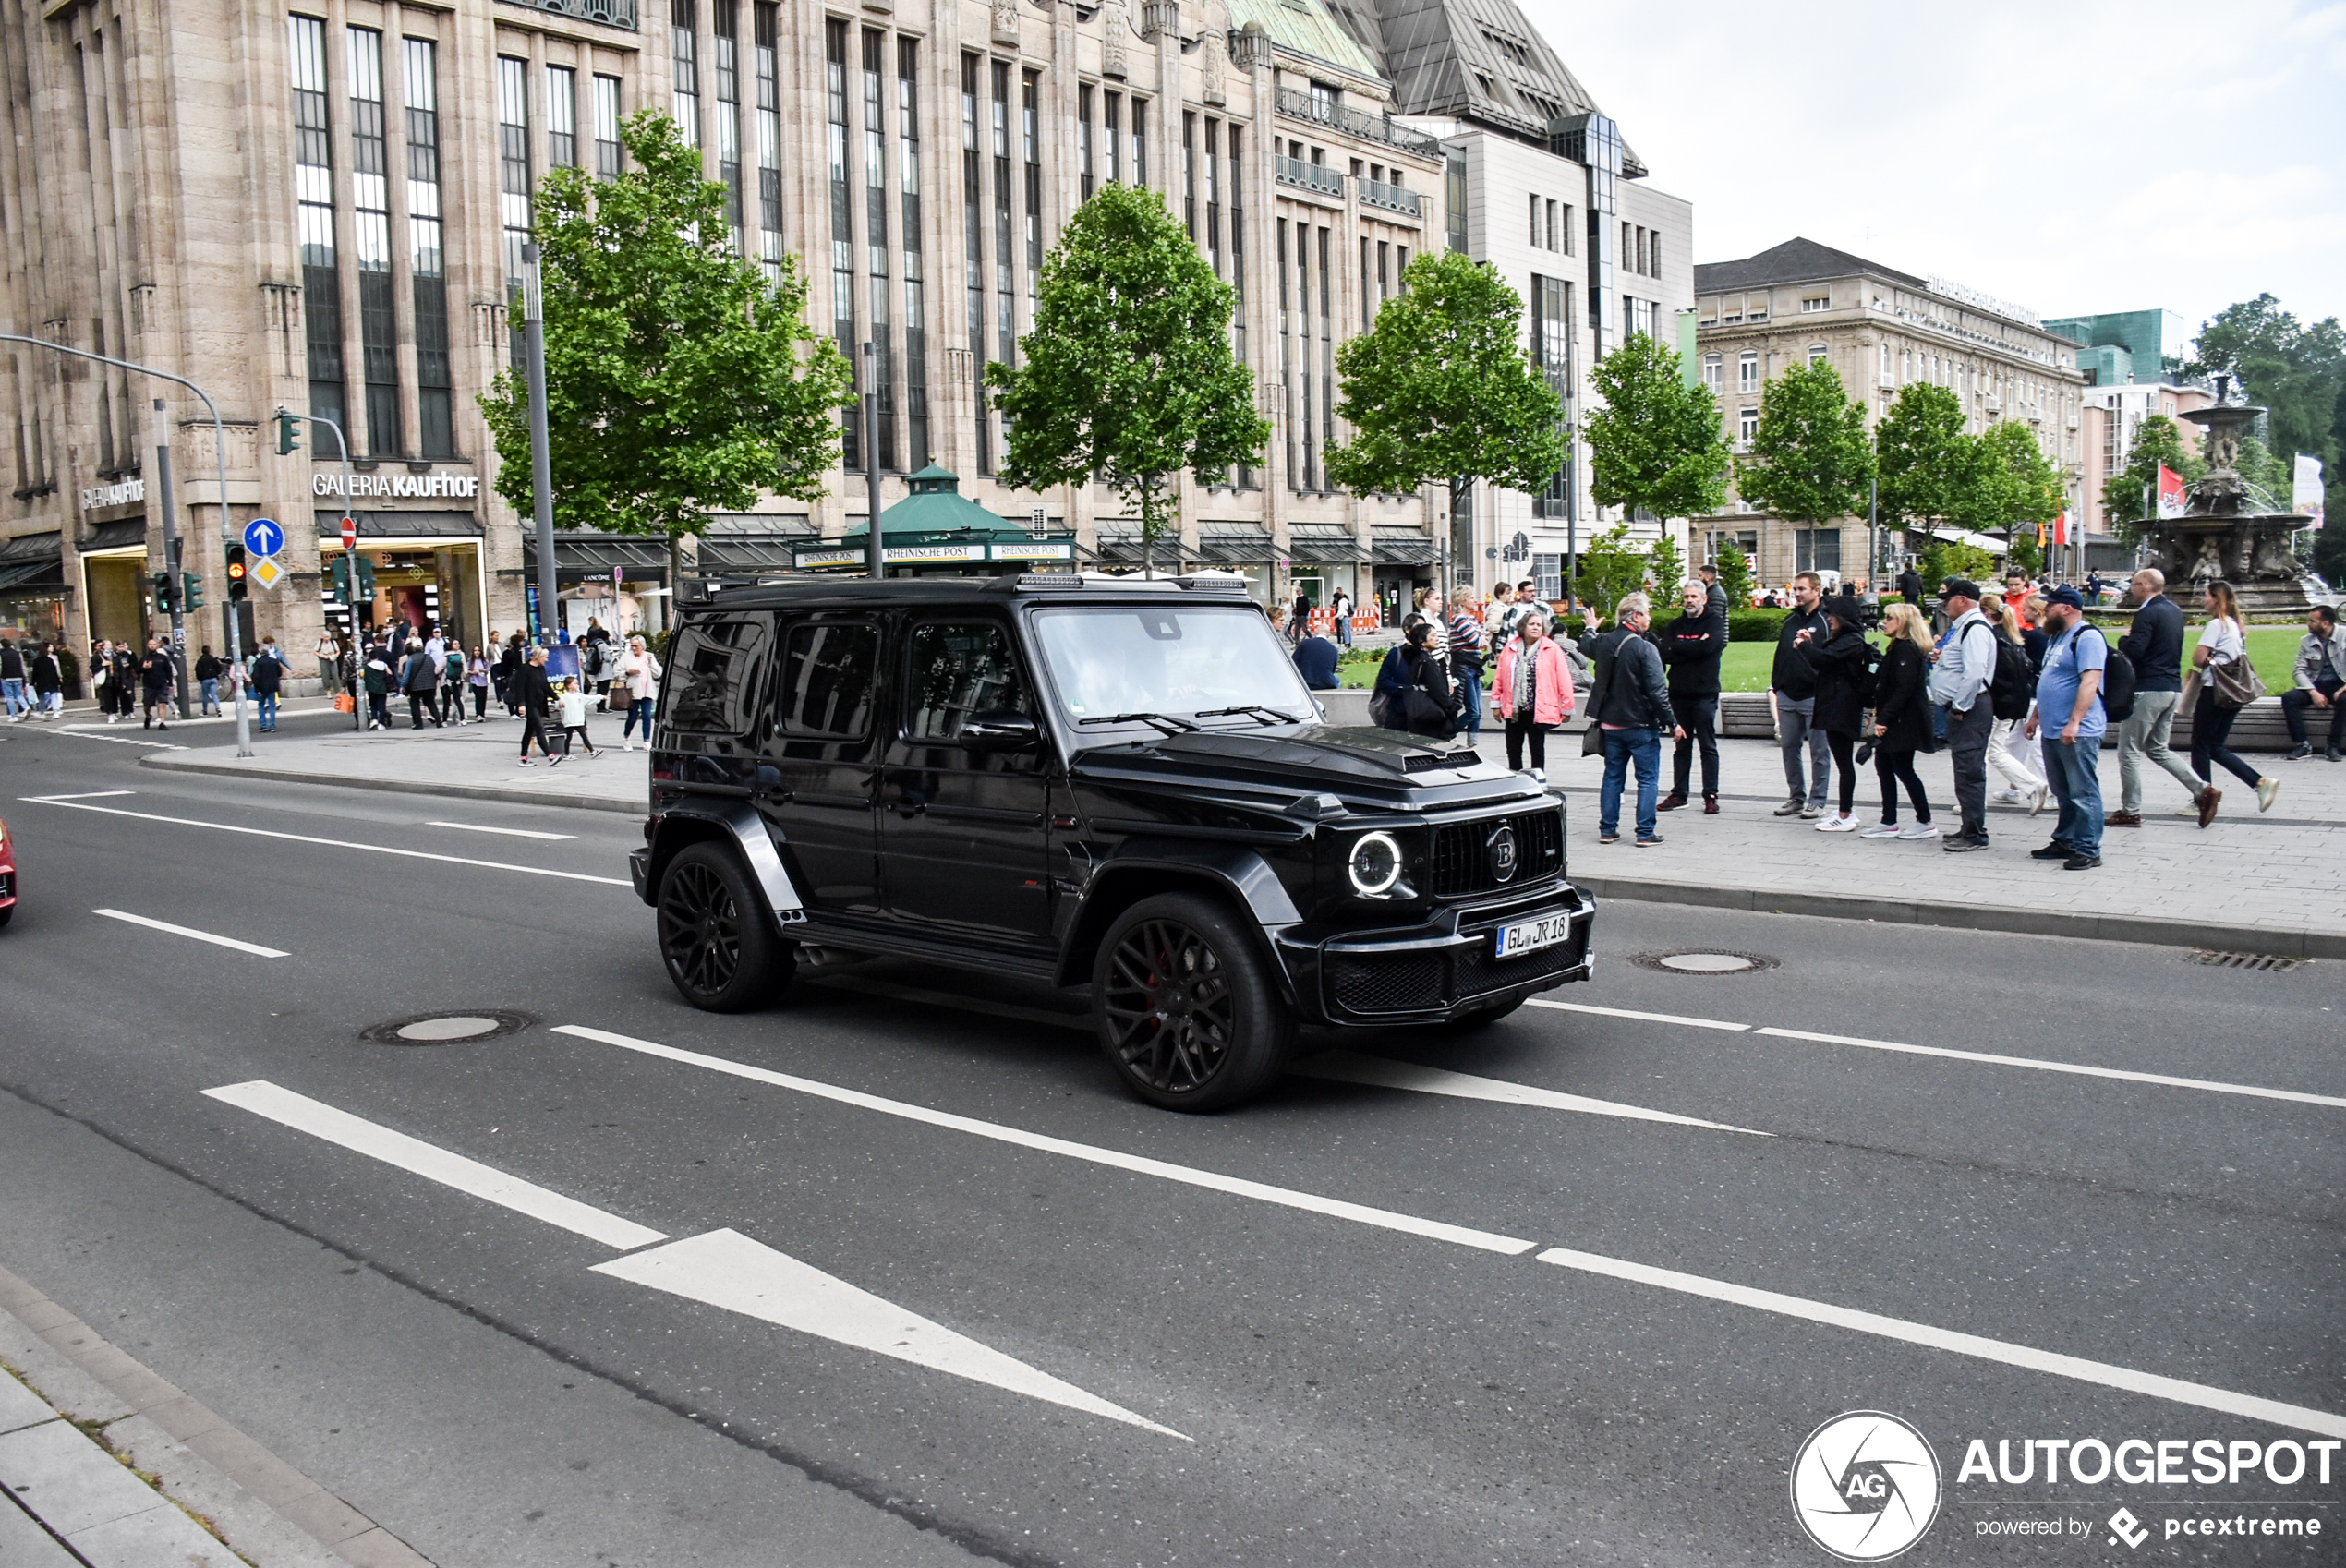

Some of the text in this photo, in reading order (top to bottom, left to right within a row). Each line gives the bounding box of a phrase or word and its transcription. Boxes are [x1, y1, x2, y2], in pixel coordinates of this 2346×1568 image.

[311, 474, 392, 496] GALERIA
[804, 550, 855, 562] RHEINISCHE POST
[887, 546, 968, 558] RHEINISCHE POST
[1001, 545, 1059, 555] RHEINISCHE POST
[1508, 917, 1565, 949] GL JR 18
